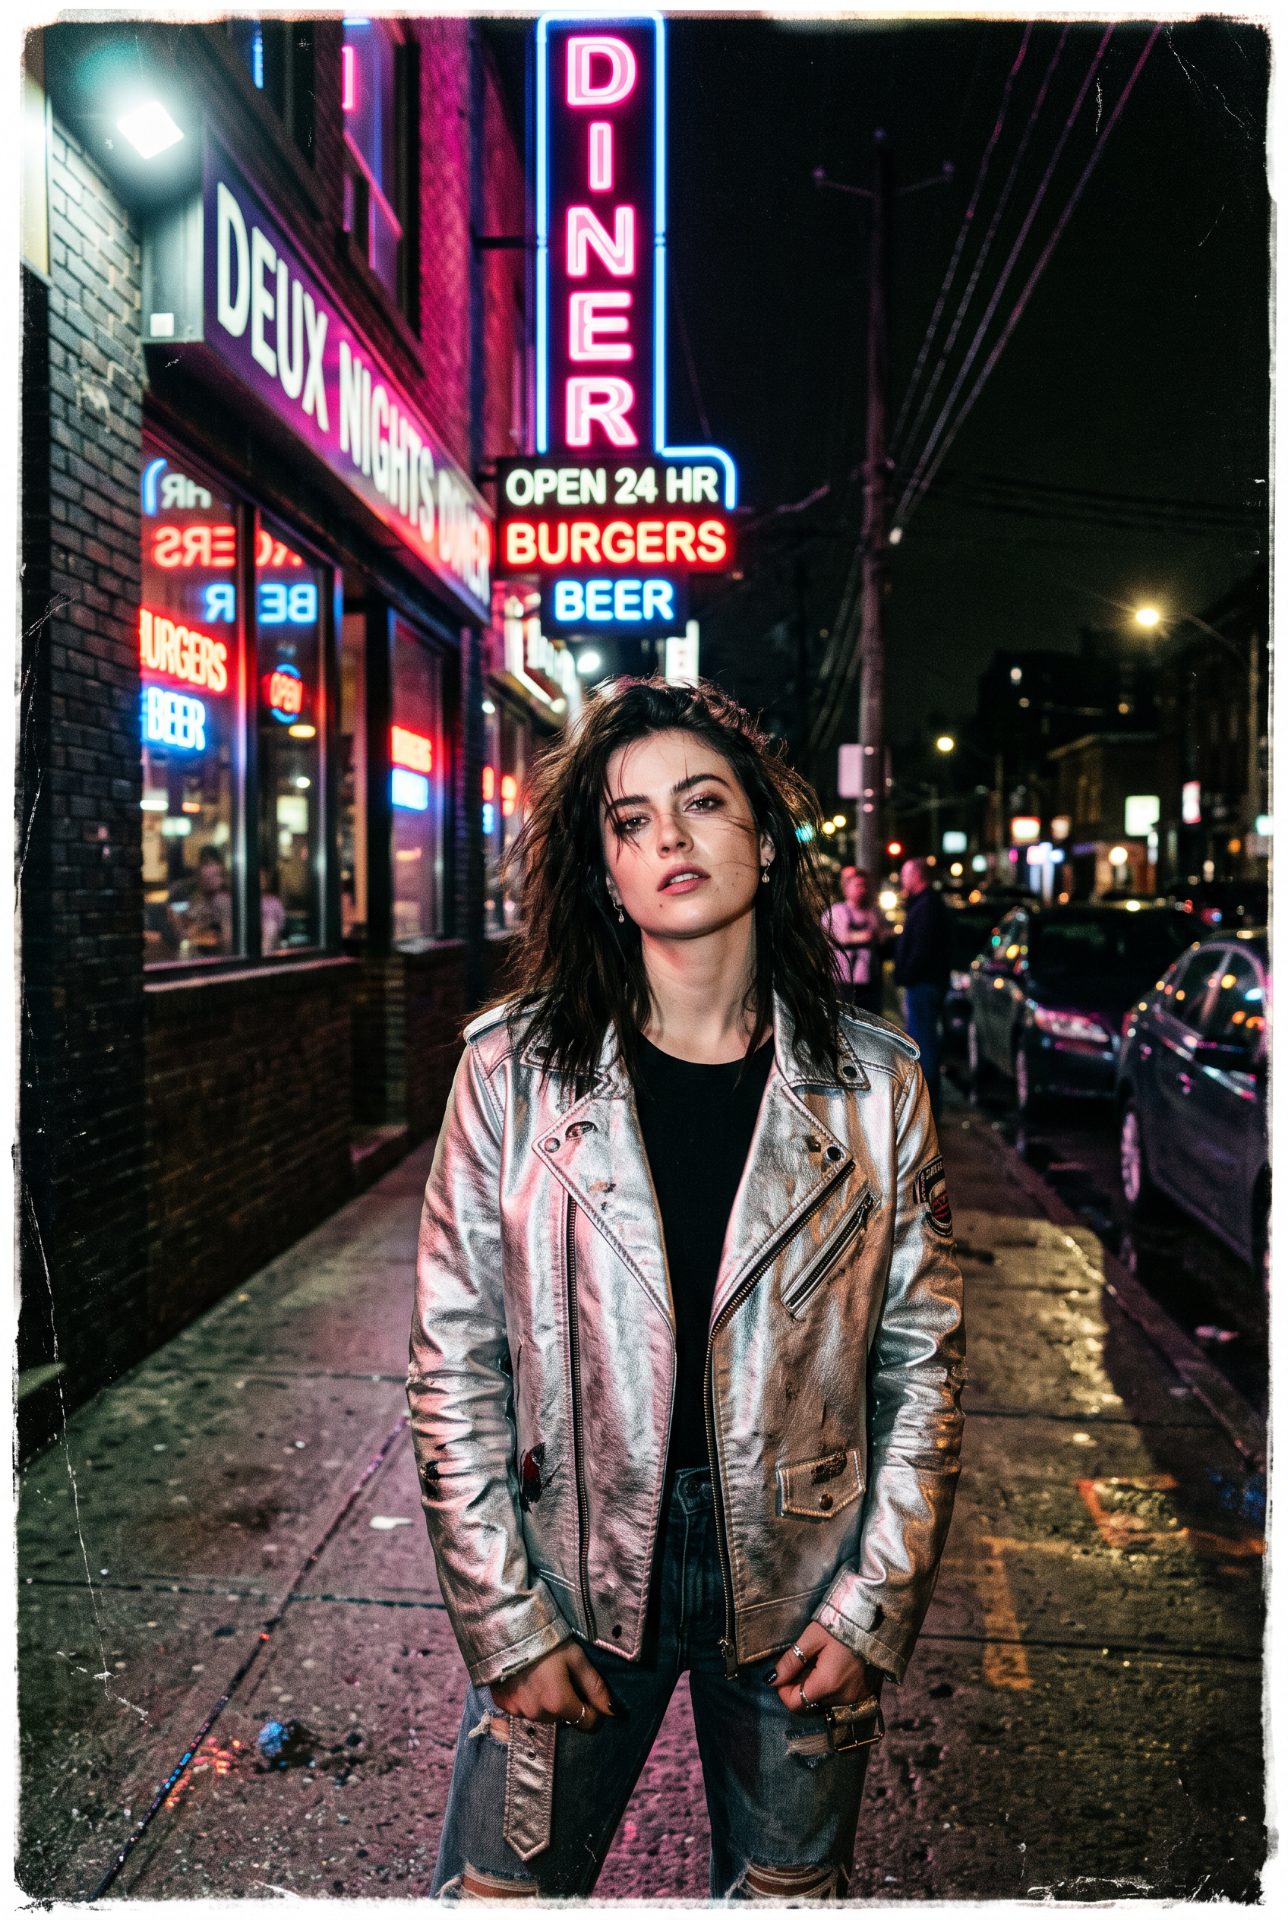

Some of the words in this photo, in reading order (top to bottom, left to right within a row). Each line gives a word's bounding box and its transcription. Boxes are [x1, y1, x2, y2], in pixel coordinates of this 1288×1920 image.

[566, 36, 638, 448] DINER
[217, 181, 329, 433] DEUX
[339, 339, 435, 543] NIGHTS
[506, 468, 606, 506] OPEN
[614, 466, 658, 505] 24
[666, 466, 719, 504] HR
[506, 519, 727, 565] BURGERS
[554, 579, 675, 622] BEER
[147, 677, 206, 751] BEER
